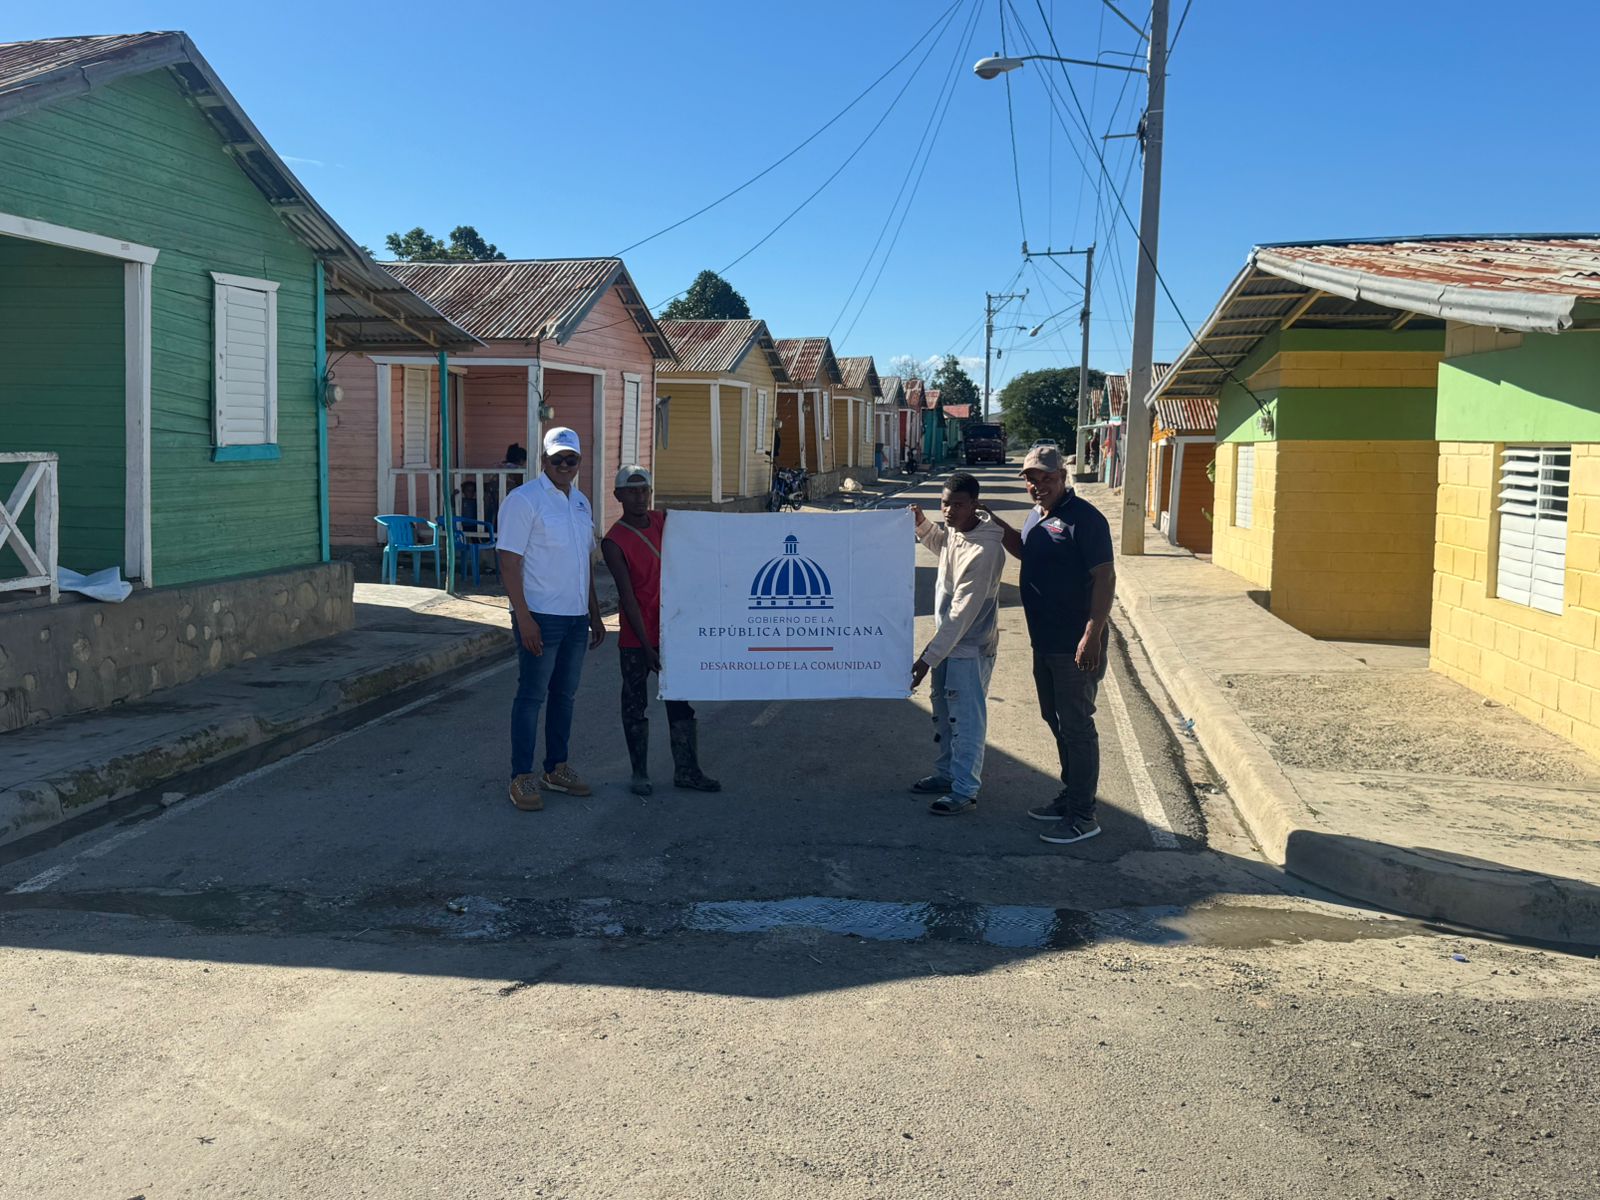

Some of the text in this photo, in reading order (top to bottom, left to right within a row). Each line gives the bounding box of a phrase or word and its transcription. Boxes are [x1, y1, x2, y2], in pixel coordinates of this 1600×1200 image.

[747, 616, 834, 624] GOBIERNO DE LA
[698, 624, 884, 637] REPÚBLICA DOMINICANA
[700, 661, 882, 671] DESARROLLO DE LA COMUNIDAD
